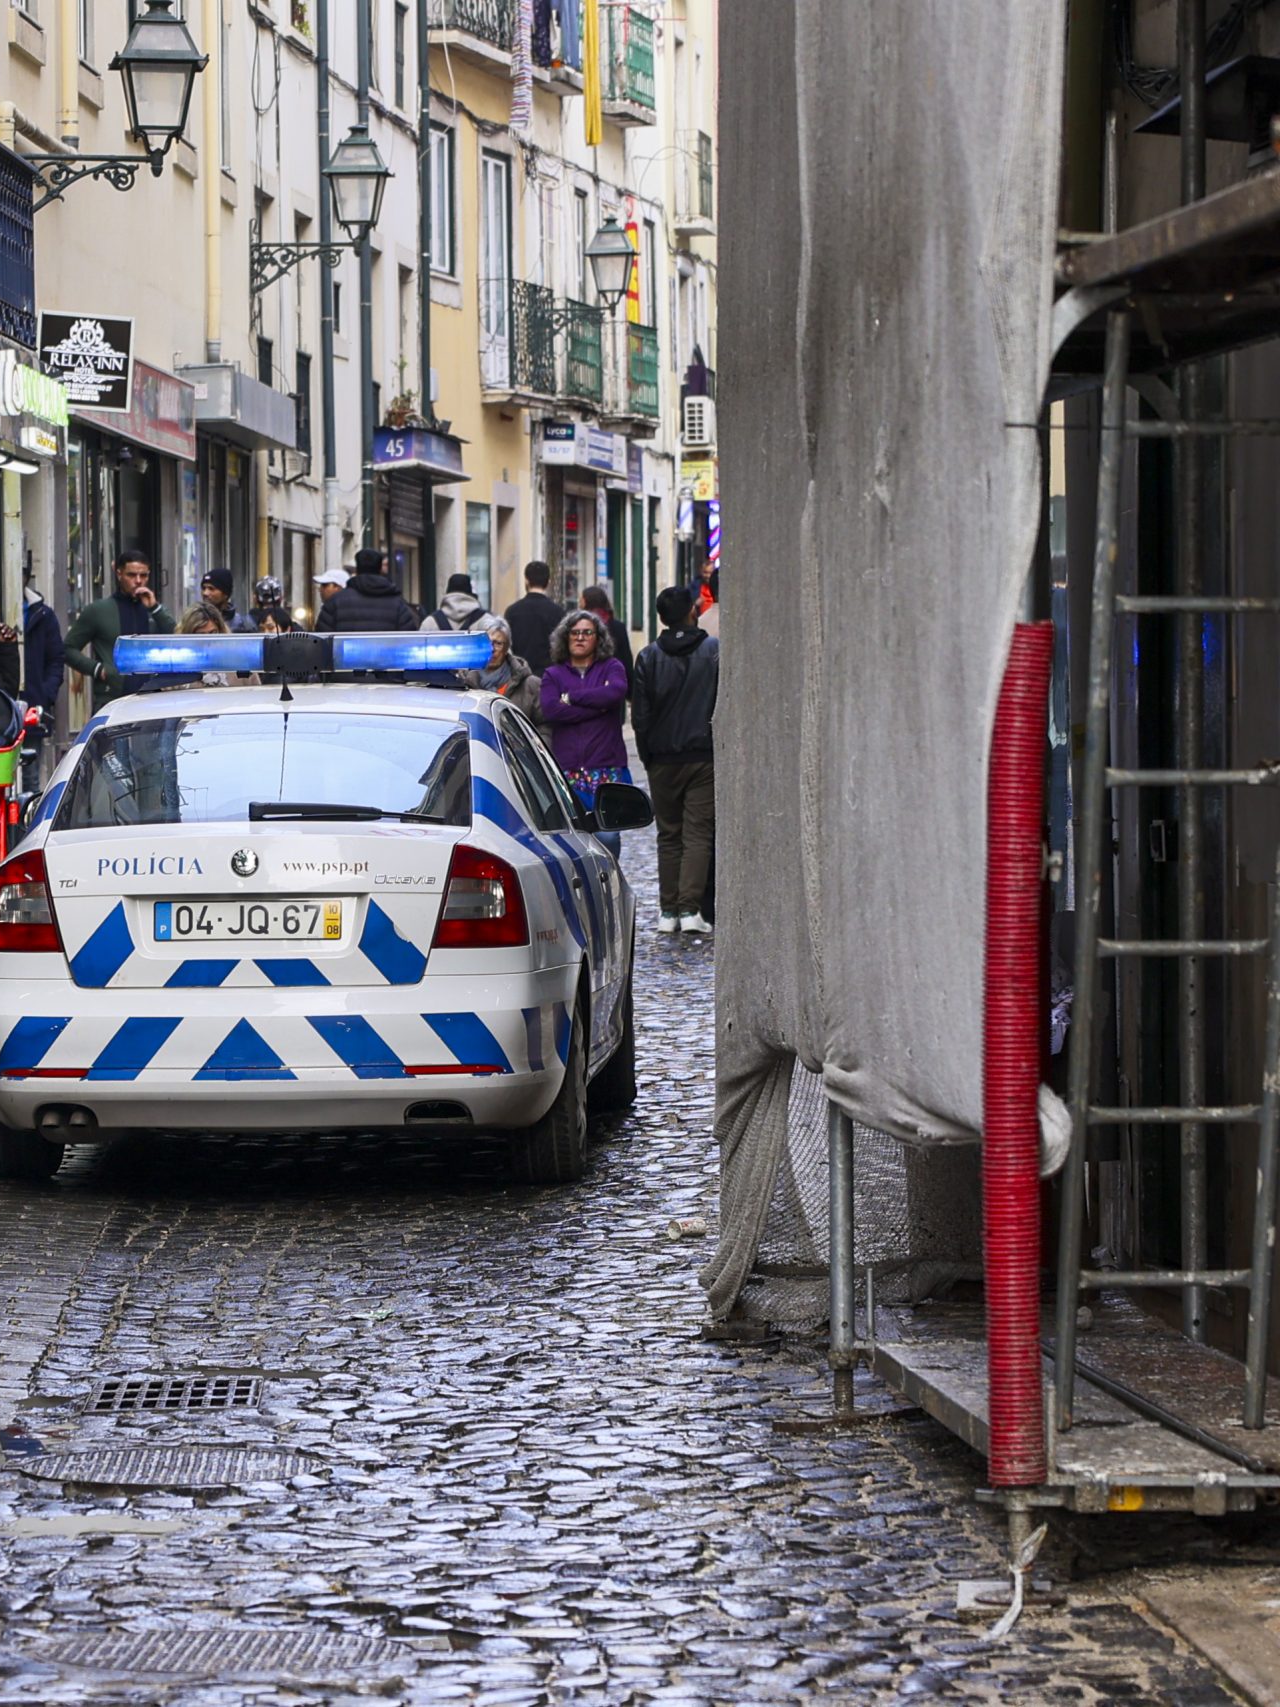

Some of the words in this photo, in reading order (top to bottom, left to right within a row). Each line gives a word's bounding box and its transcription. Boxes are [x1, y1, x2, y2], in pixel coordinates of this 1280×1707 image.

[50, 352, 124, 371] RELAX-INN
[74, 366, 96, 375] HOTEL
[546, 427, 567, 437] Lyca
[385, 439, 405, 457] 45
[98, 852, 204, 876] POLÍCIA
[374, 874, 436, 885] Octavia
[328, 905, 338, 914] 10
[160, 925, 167, 934] P
[326, 925, 339, 935] 08
